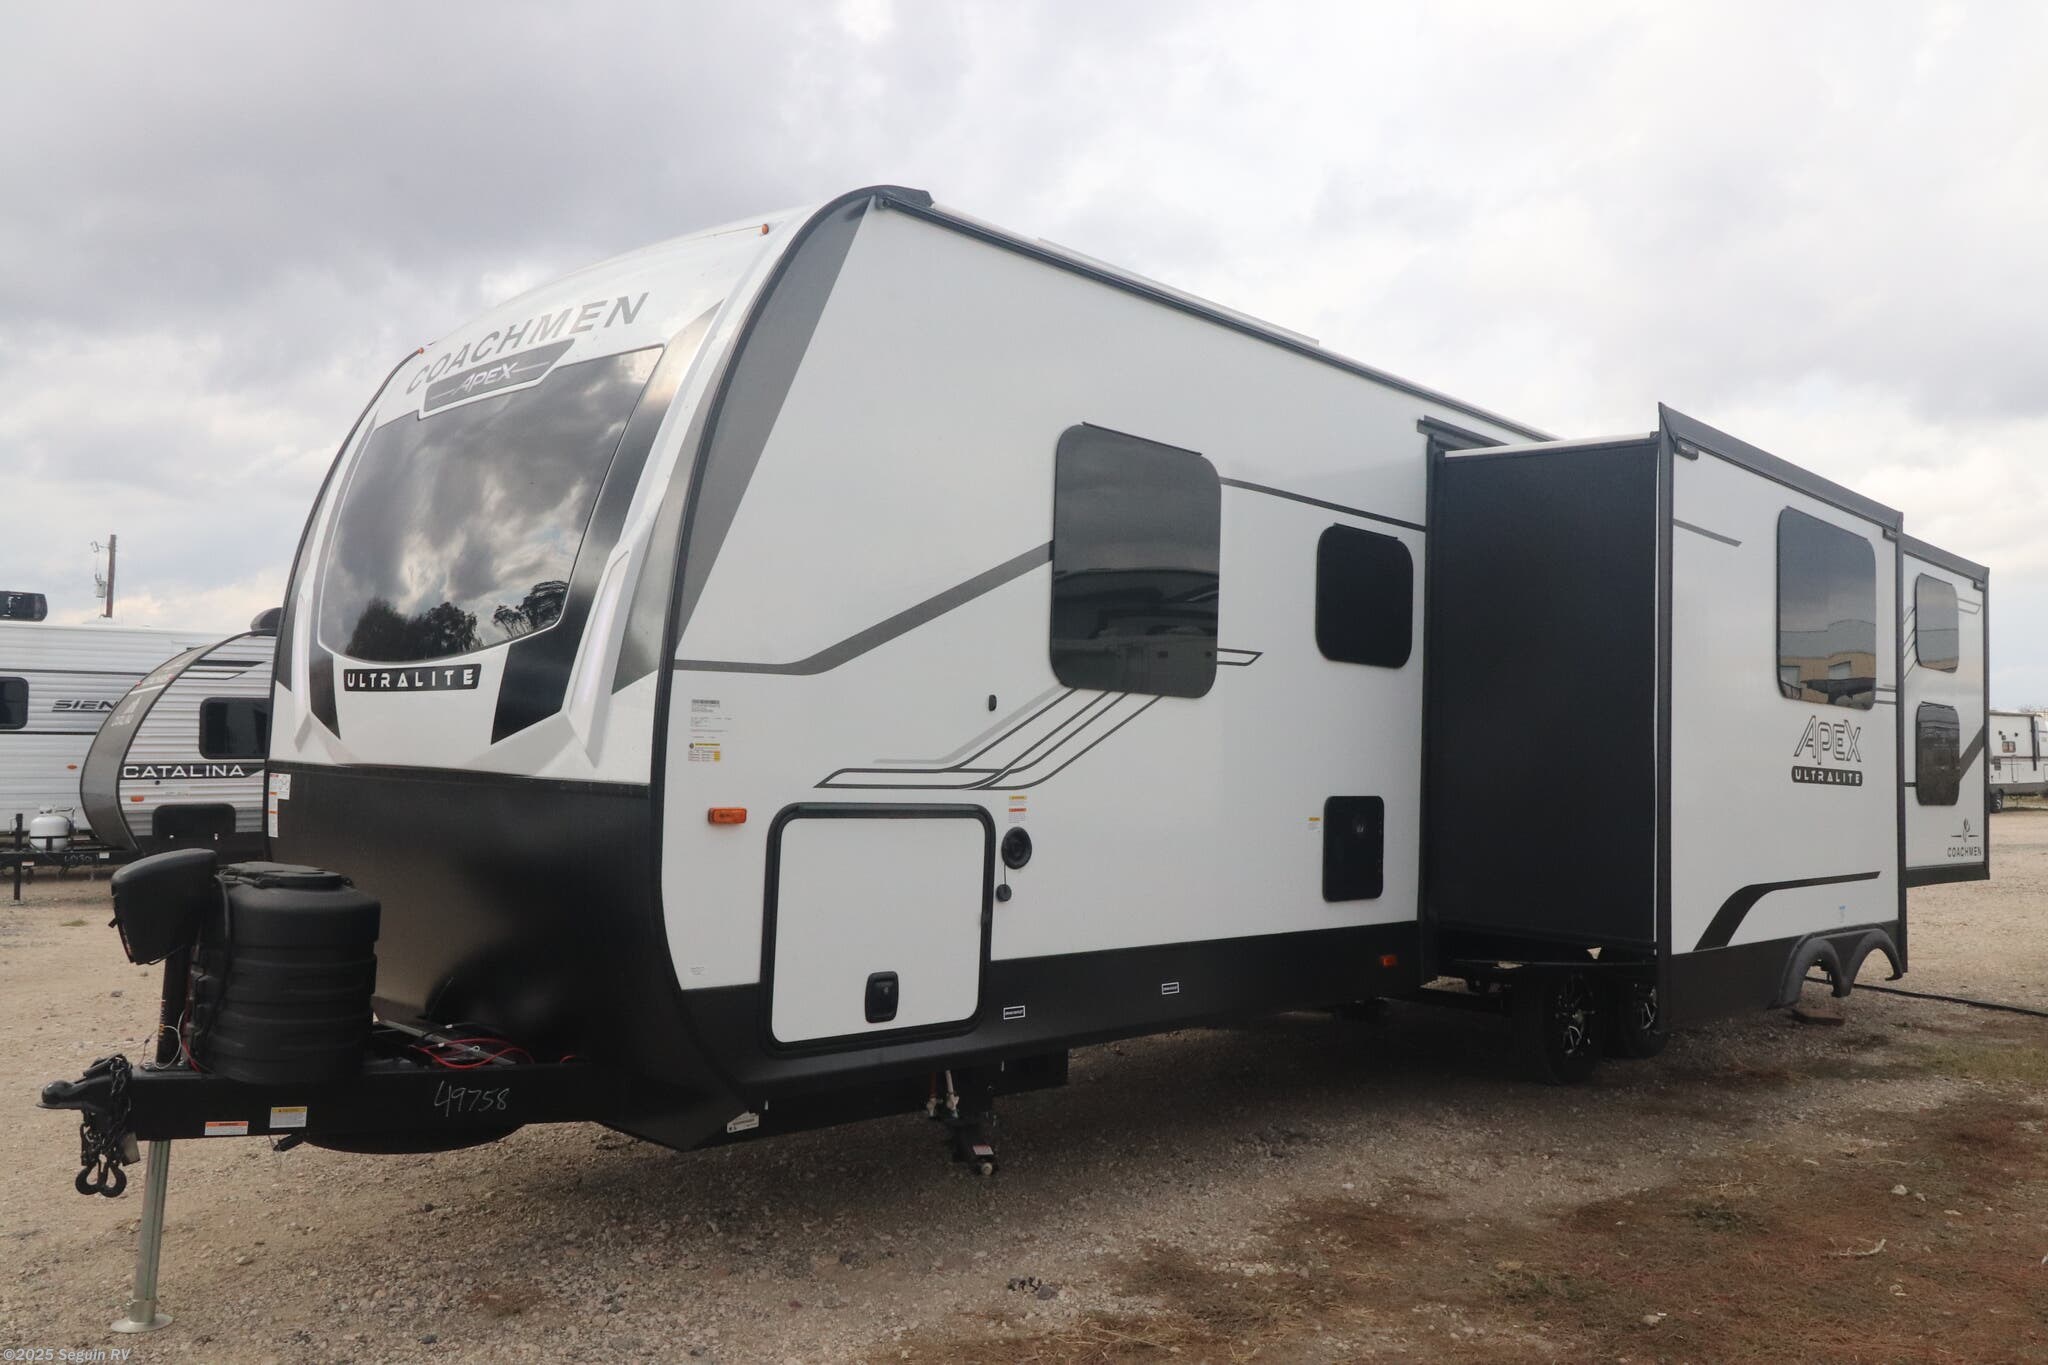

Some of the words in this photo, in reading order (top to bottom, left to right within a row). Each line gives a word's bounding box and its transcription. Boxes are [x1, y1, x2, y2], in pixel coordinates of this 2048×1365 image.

[407, 292, 649, 394] COACHMEN
[454, 362, 518, 395] APEX
[347, 668, 474, 688] ULTRALITE
[1794, 715, 1862, 765] APEX
[123, 765, 245, 778] CATALINA
[1795, 769, 1860, 784] ULTRALITE
[434, 1080, 510, 1117] 49758
